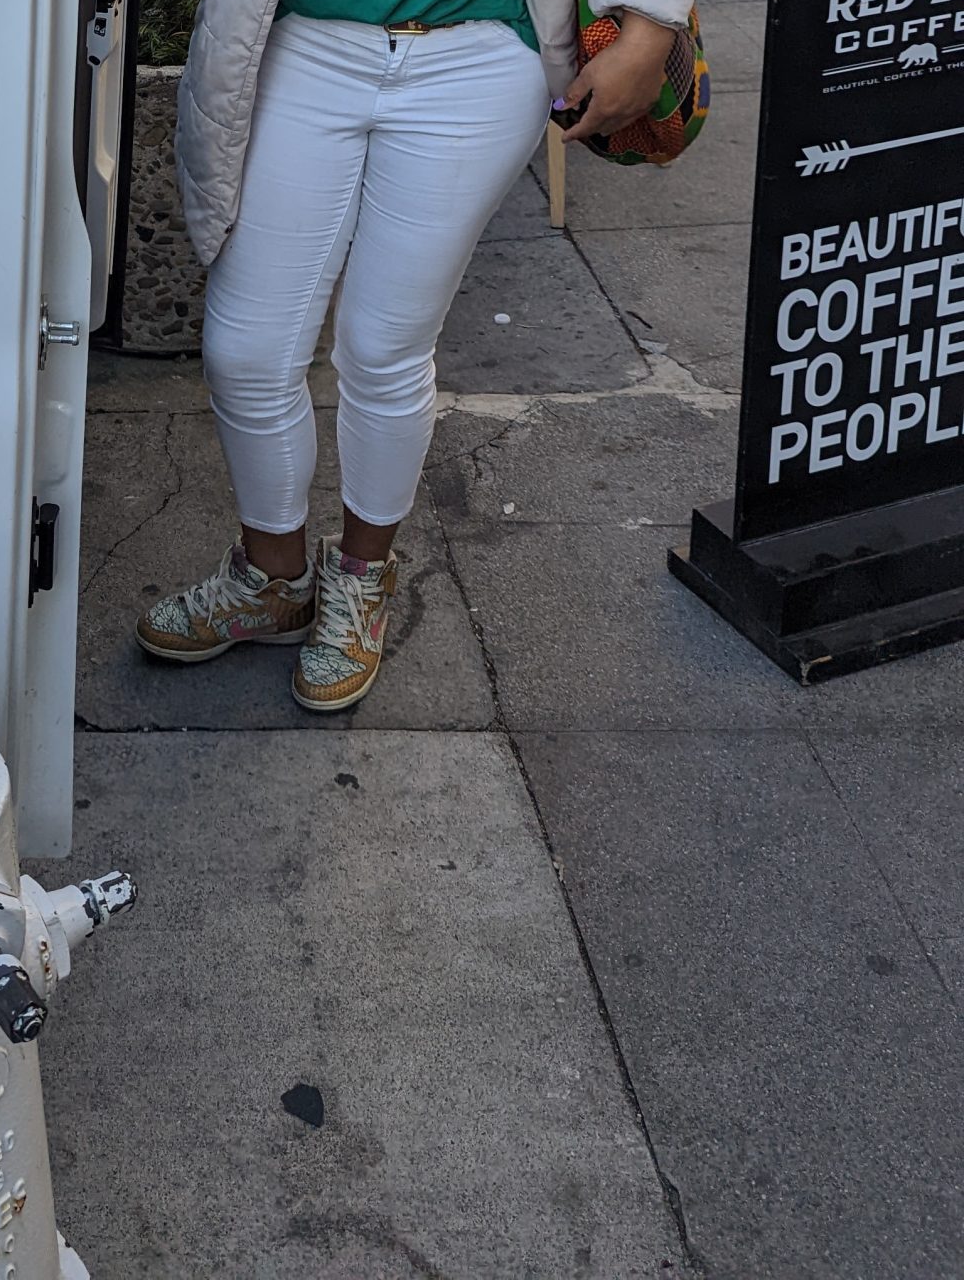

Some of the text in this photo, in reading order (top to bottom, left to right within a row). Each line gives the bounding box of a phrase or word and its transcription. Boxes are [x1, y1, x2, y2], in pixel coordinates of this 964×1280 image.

[822, 78, 880, 94] BEAUTIFUL
[884, 69, 924, 82] COFFEE
[780, 198, 964, 280] BEAUTIF
[770, 320, 964, 416] TO THE
[768, 386, 964, 484] PEOPL
